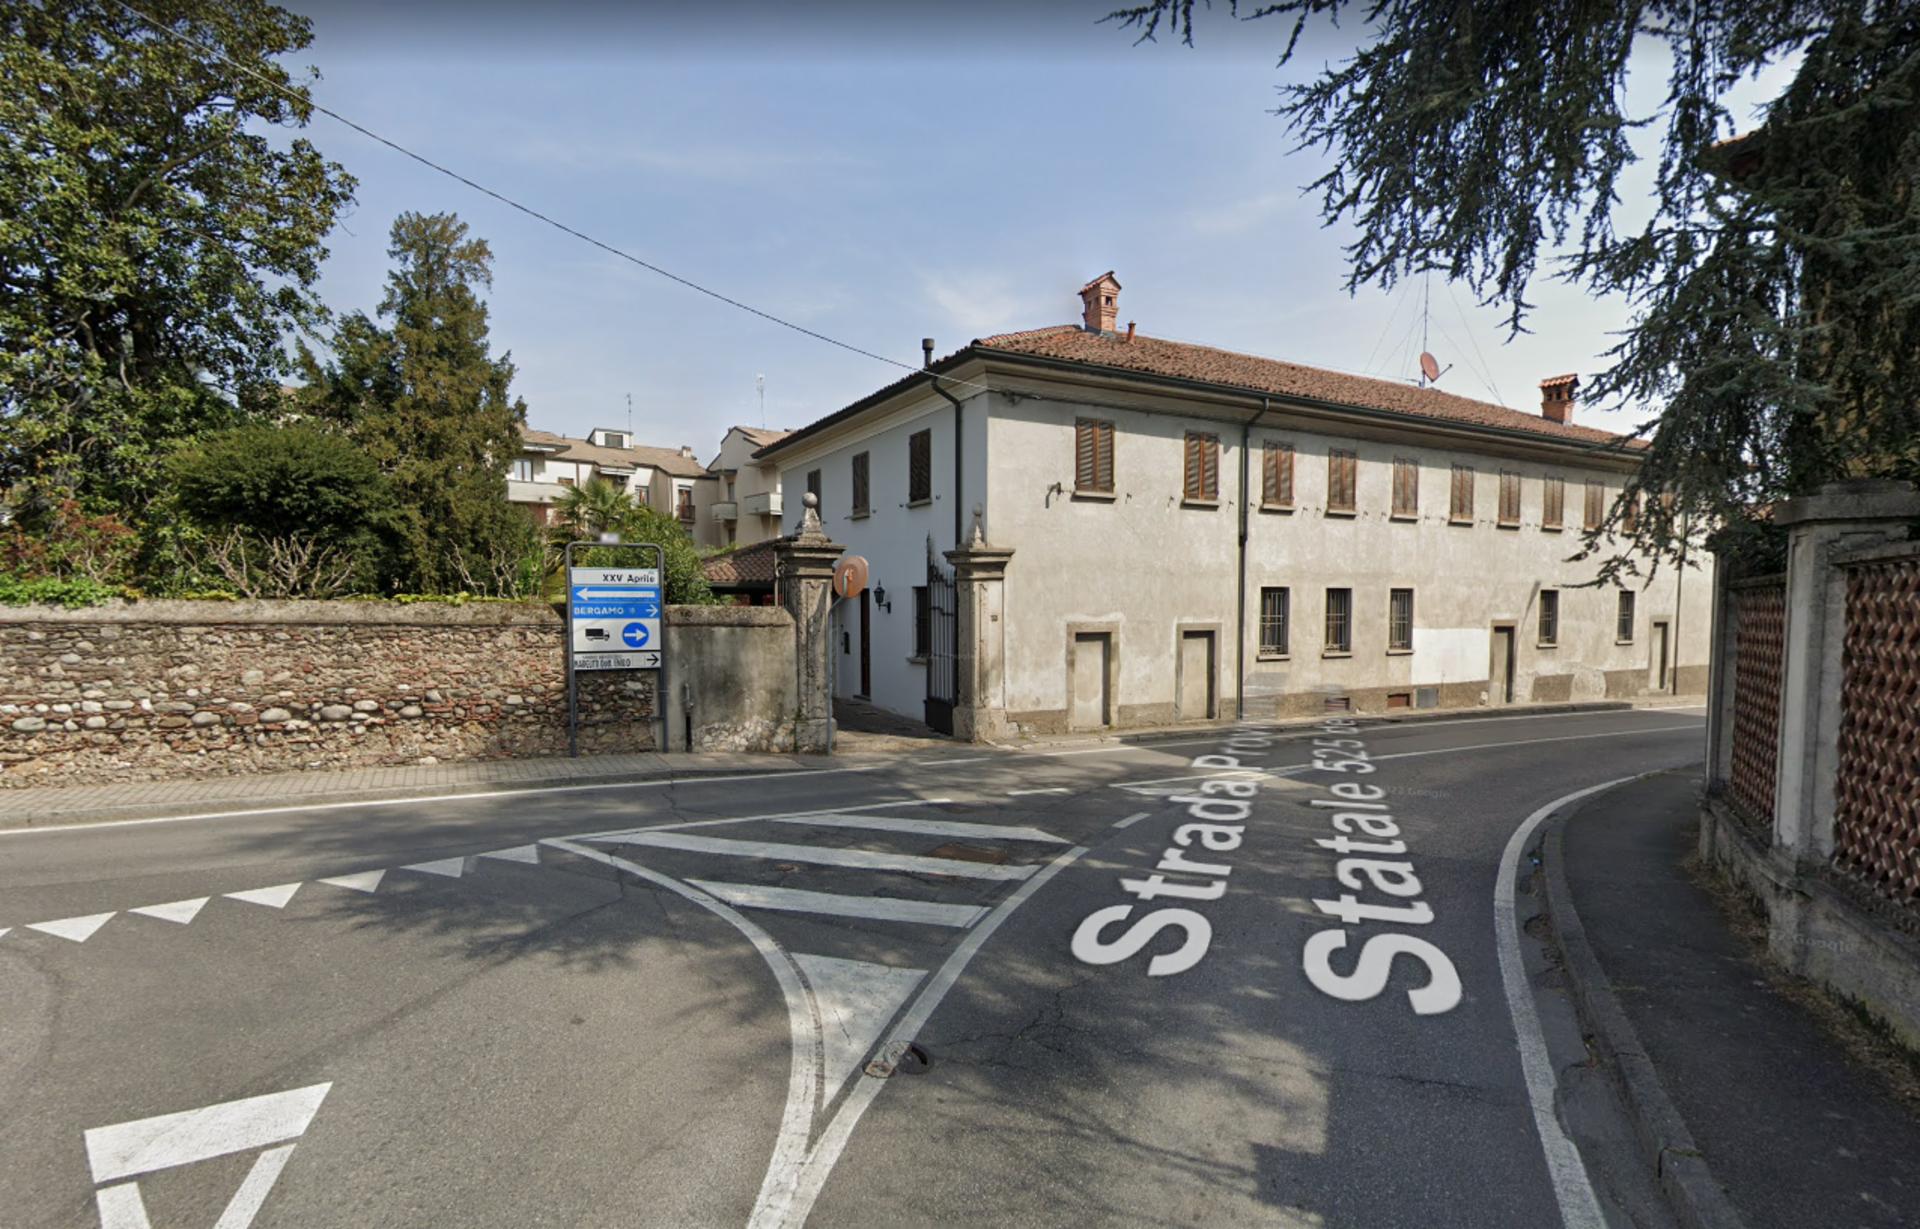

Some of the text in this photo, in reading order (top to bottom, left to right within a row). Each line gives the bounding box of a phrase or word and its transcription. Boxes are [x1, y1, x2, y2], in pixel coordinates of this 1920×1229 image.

[602, 574, 655, 584] XXV Aprile
[574, 606, 624, 615] BERGAMO
